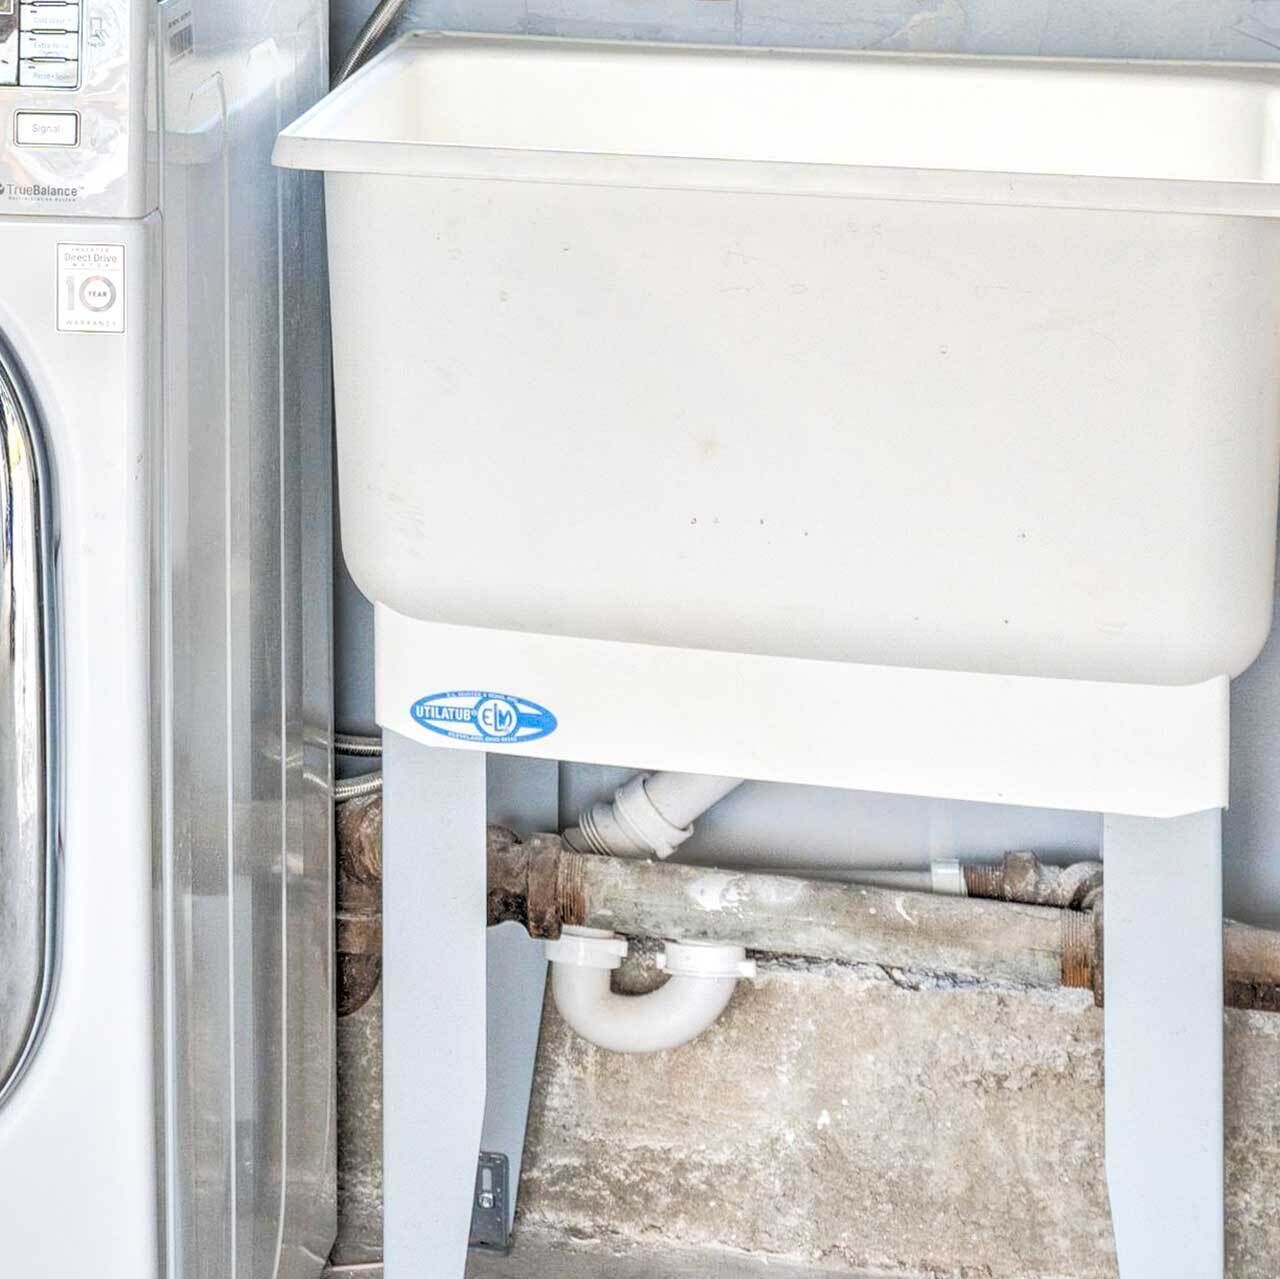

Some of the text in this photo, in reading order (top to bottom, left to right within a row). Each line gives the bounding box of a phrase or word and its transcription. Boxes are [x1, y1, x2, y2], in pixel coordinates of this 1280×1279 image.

[31, 123, 61, 134] Signal
[64, 252, 118, 263] Direct Drive
